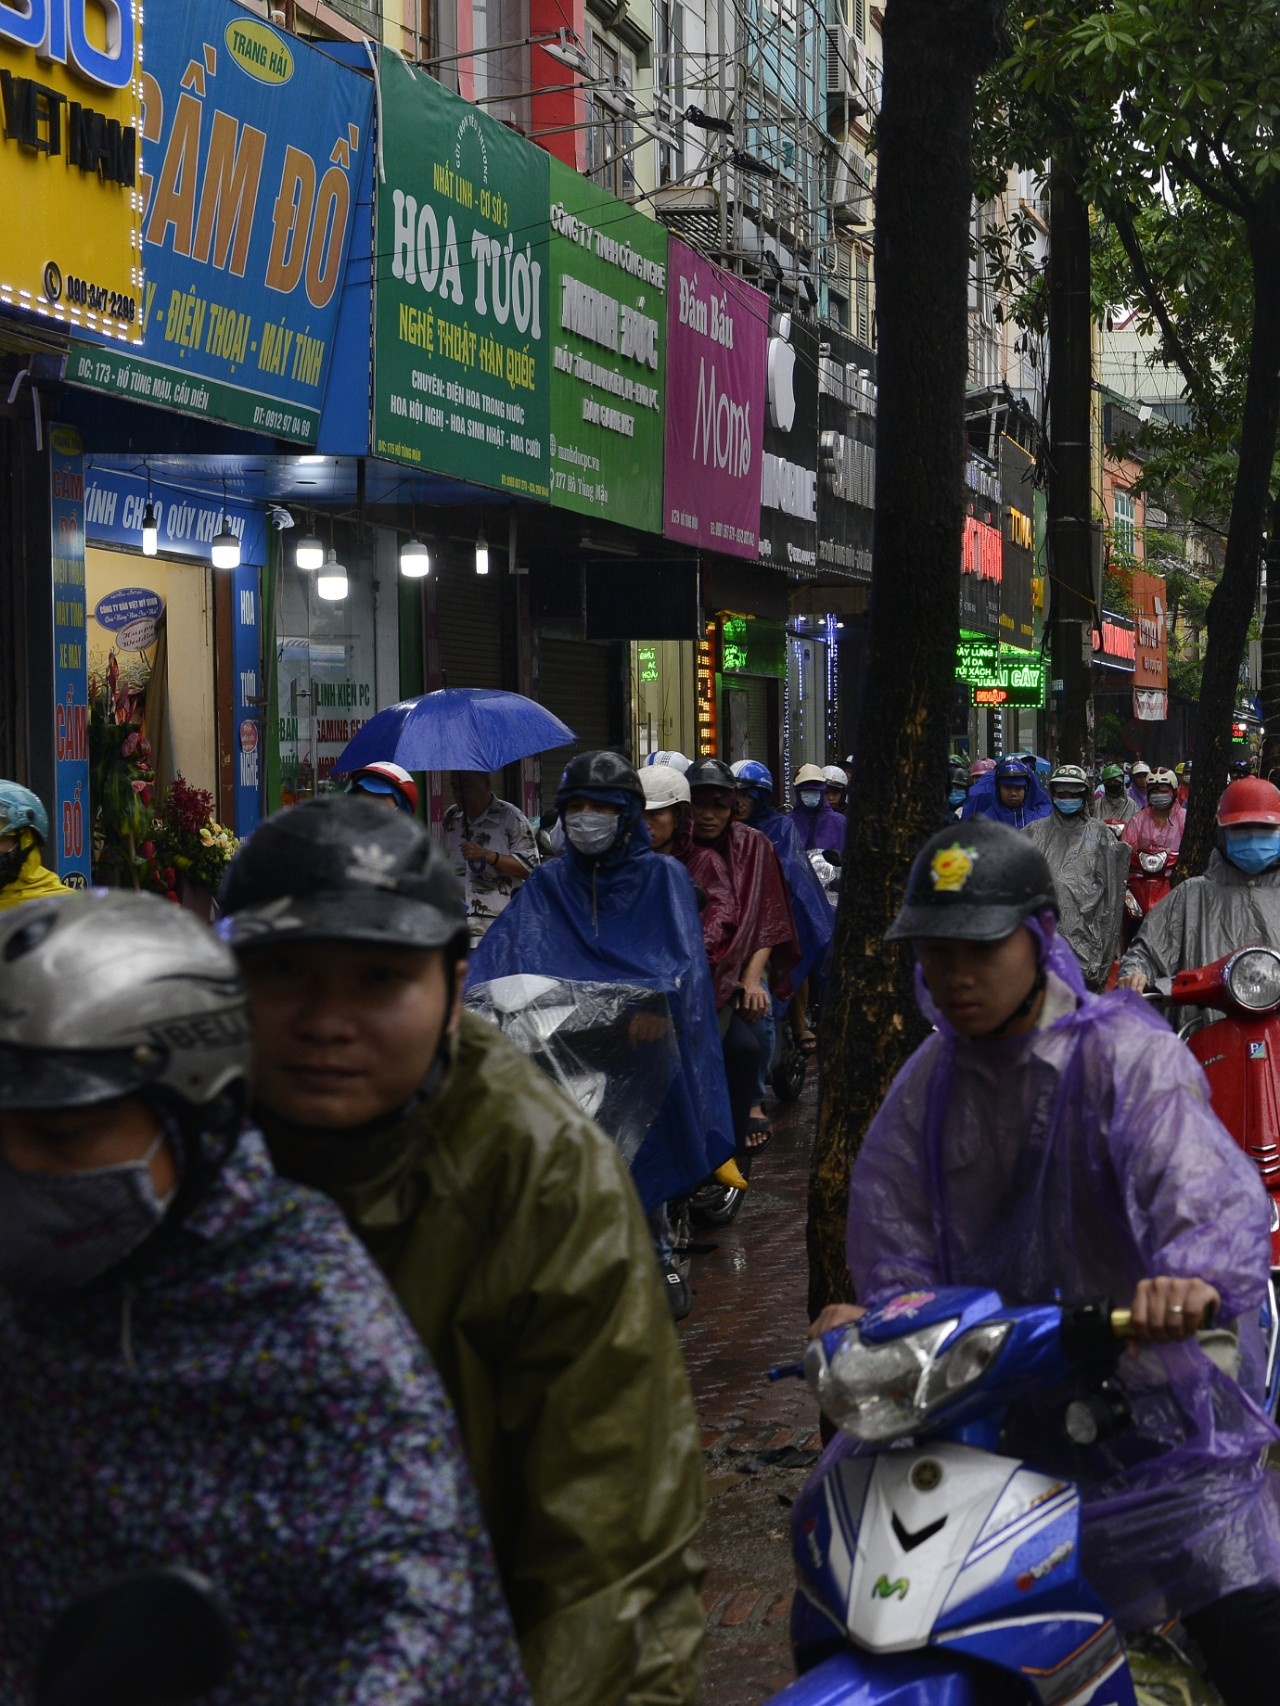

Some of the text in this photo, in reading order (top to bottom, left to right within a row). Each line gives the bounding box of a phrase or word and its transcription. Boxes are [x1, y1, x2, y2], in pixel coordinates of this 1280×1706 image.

[233, 29, 287, 78] TRANG HẢI
[265, 123, 359, 309] ĐỒ
[433, 160, 454, 199] NHẤT
[456, 174, 472, 210] LINH
[502, 202, 508, 229] 3
[392, 189, 542, 341] HOA TƯƠI
[550, 202, 579, 242] CÔNG
[579, 221, 593, 250] TY
[594, 230, 619, 265] TNHH
[619, 241, 643, 278] CÔNG
[165, 284, 202, 358] ĐIỆN
[209, 301, 252, 373] THOẠI
[258, 316, 297, 377] MÁY
[296, 323, 325, 388] TÍNH
[679, 273, 734, 350] Đầm Bầu
[400, 303, 536, 391] NGHỆ THUẬT HÀN QUỐC
[78, 357, 94, 378] ĐC:
[95, 362, 111, 384] 173
[117, 363, 130, 389] HỒ
[131, 368, 151, 395] TÙNG
[152, 377, 173, 403] MẬU,
[412, 370, 525, 426] CHUYÊN: ĐIỆN HOA TRONG NƯỚC
[253, 406, 266, 426] ĐT:
[265, 412, 283, 430] 0912
[282, 415, 292, 432] 97
[301, 420, 311, 438] 69
[391, 394, 541, 459] HOA HỘI NGHỊ HOA SINH NHẬT HOA CƯỚI
[600, 405, 622, 434] GAME
[693, 356, 751, 478] Moms
[240, 590, 255, 625] HOA
[60, 639, 82, 670] XE MÁY
[962, 657, 984, 666] VÍ DA
[968, 665, 992, 676] XÁCH
[1010, 667, 1040, 688] CÂY
[56, 684, 88, 762] CẦM
[337, 679, 357, 712] KIỆN
[359, 684, 370, 706] PC
[280, 712, 299, 742] BÁN
[63, 780, 83, 859] ĐỒ
